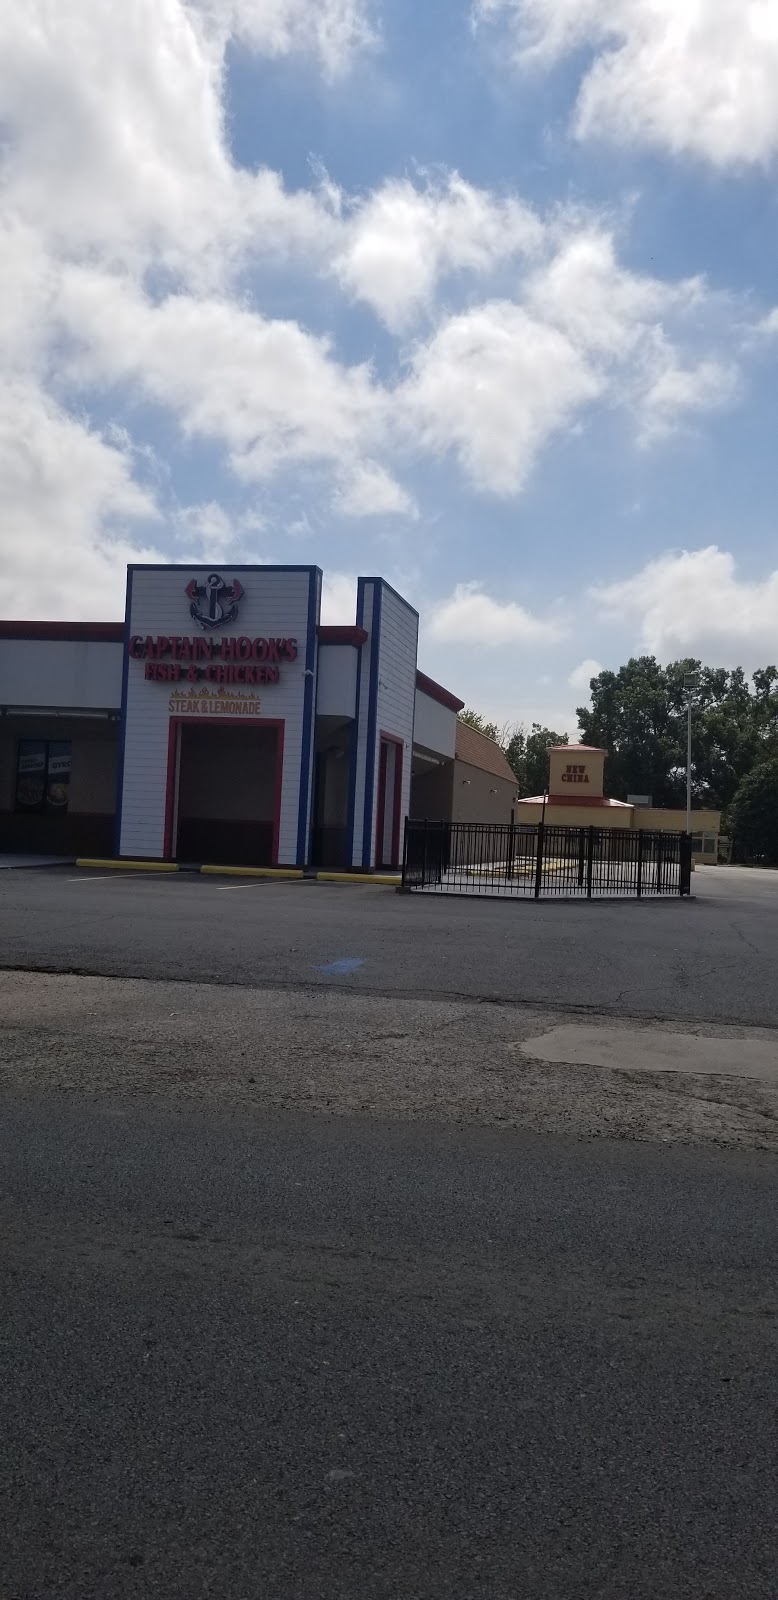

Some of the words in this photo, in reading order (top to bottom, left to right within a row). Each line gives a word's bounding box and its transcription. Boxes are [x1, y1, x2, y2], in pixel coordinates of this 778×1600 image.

[128, 635, 213, 660] CAPTAIN
[220, 636, 297, 662] HOOK'S
[145, 663, 181, 681] FISH
[187, 664, 200, 682] &
[205, 664, 280, 683] CHICKEN
[169, 700, 199, 713] STEAK
[201, 700, 208, 713] &
[209, 700, 260, 715] LEMONADE
[566, 765, 586, 773] NEW
[561, 773, 590, 783] CHINA
